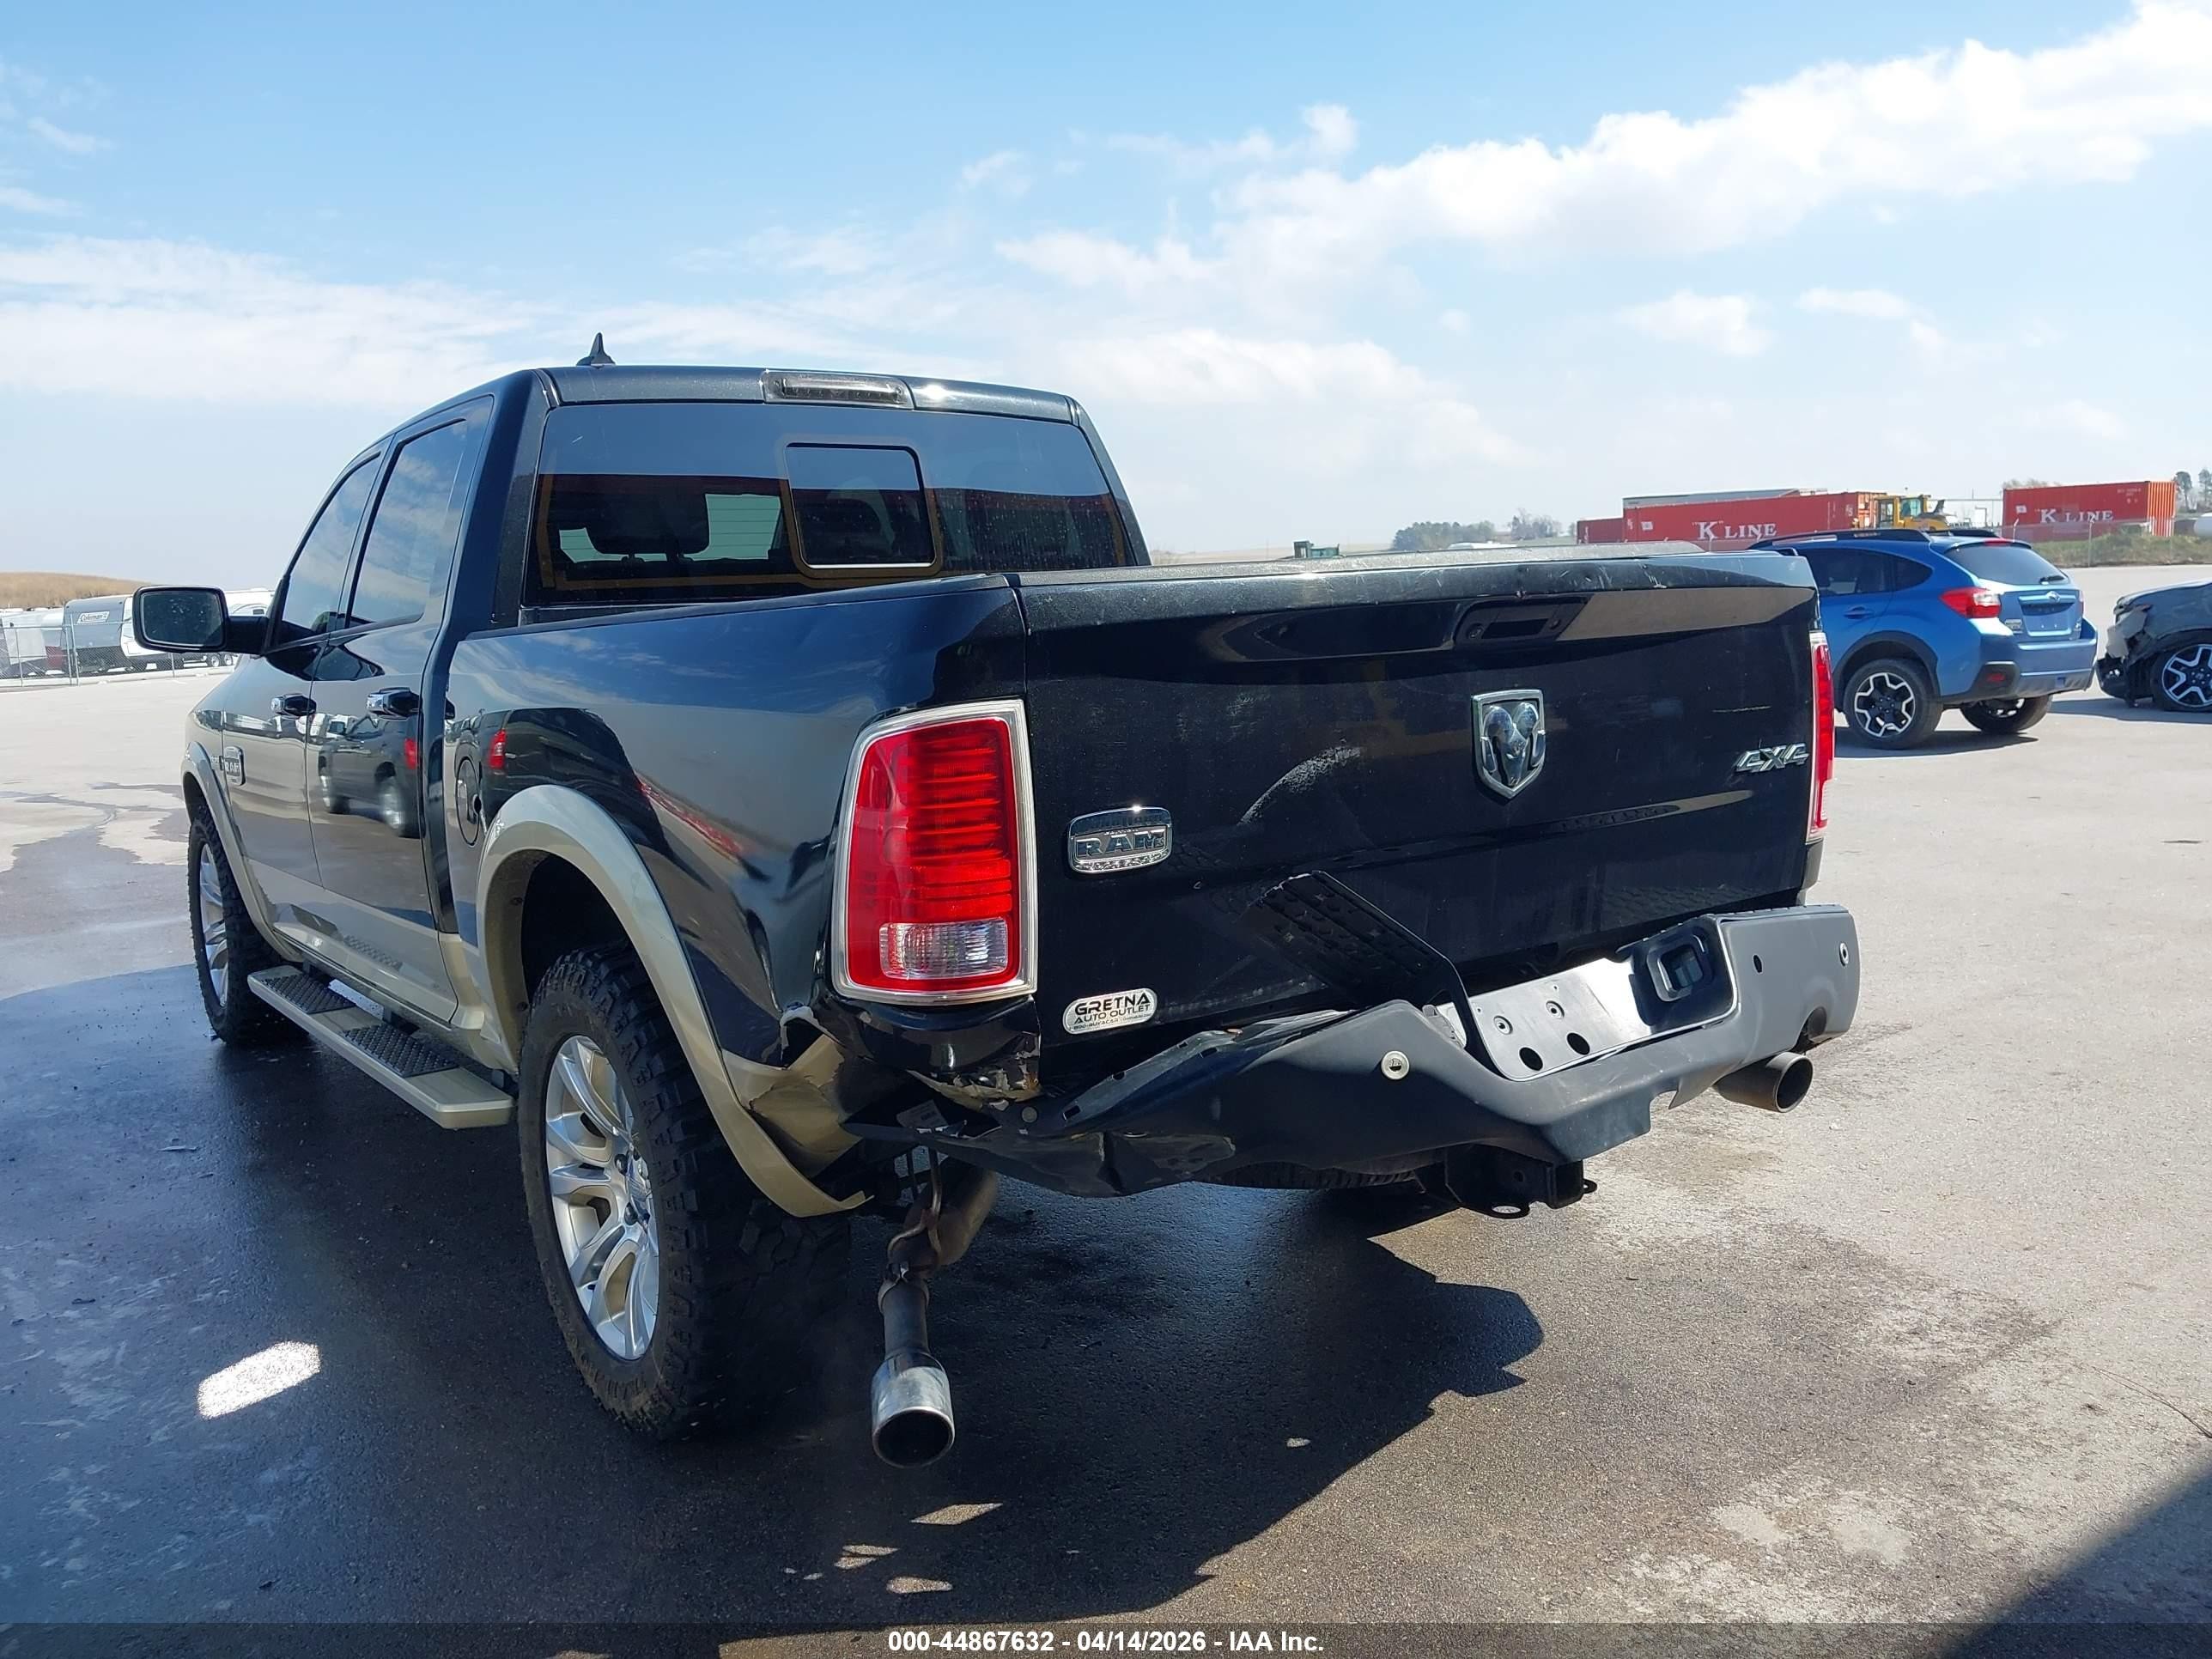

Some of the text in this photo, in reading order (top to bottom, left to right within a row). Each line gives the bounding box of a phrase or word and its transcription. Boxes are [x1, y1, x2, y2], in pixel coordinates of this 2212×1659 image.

[2065, 510, 2114, 522] LINE
[1724, 523, 1778, 538] LINE
[1076, 829, 1165, 858] RAM
[1074, 993, 1151, 1015] GRETNA
[1074, 1012, 1107, 1024] AUTO
[1109, 1004, 1151, 1018] OUTLET
